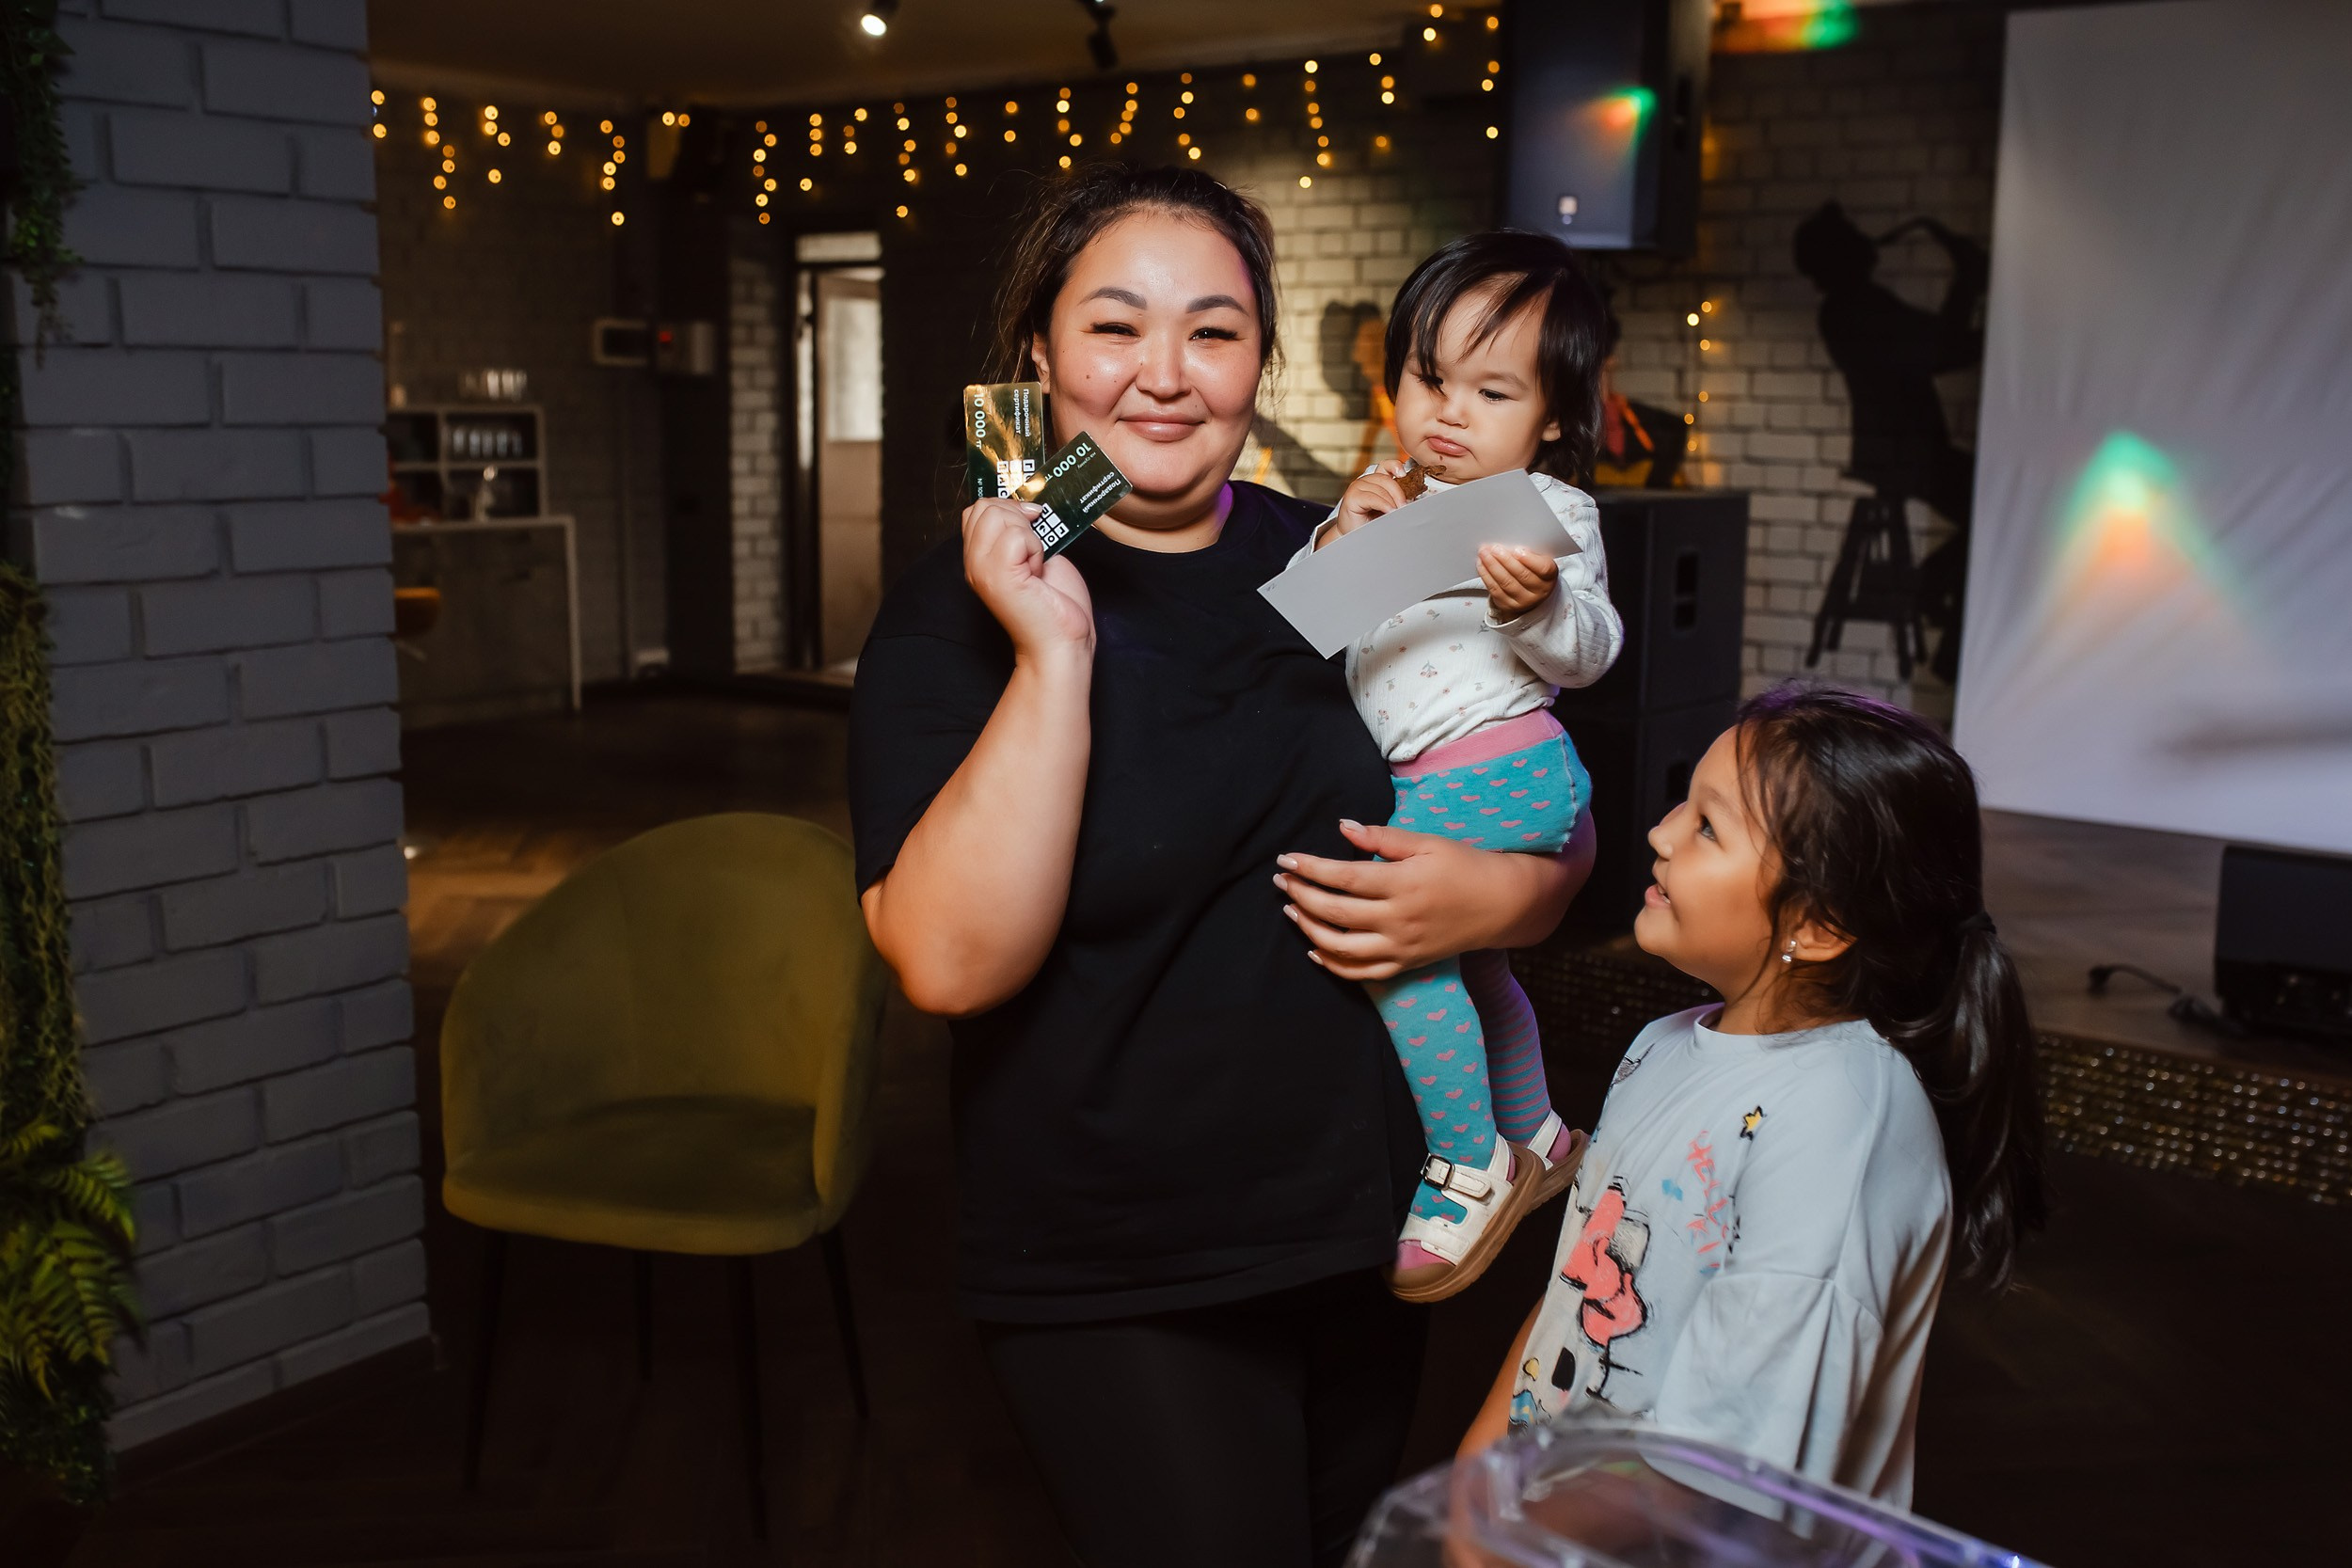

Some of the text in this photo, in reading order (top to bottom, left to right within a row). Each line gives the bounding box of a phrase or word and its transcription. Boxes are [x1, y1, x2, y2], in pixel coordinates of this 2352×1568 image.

[974, 393, 985, 407] 10
[1013, 388, 1022, 435] сертификат
[1023, 388, 1031, 437] Подарочный
[975, 410, 987, 438] 000
[1075, 442, 1092, 457] 10
[1053, 454, 1077, 478] 000
[1079, 471, 1115, 504] сертификат
[1082, 478, 1121, 514] Подарочный
